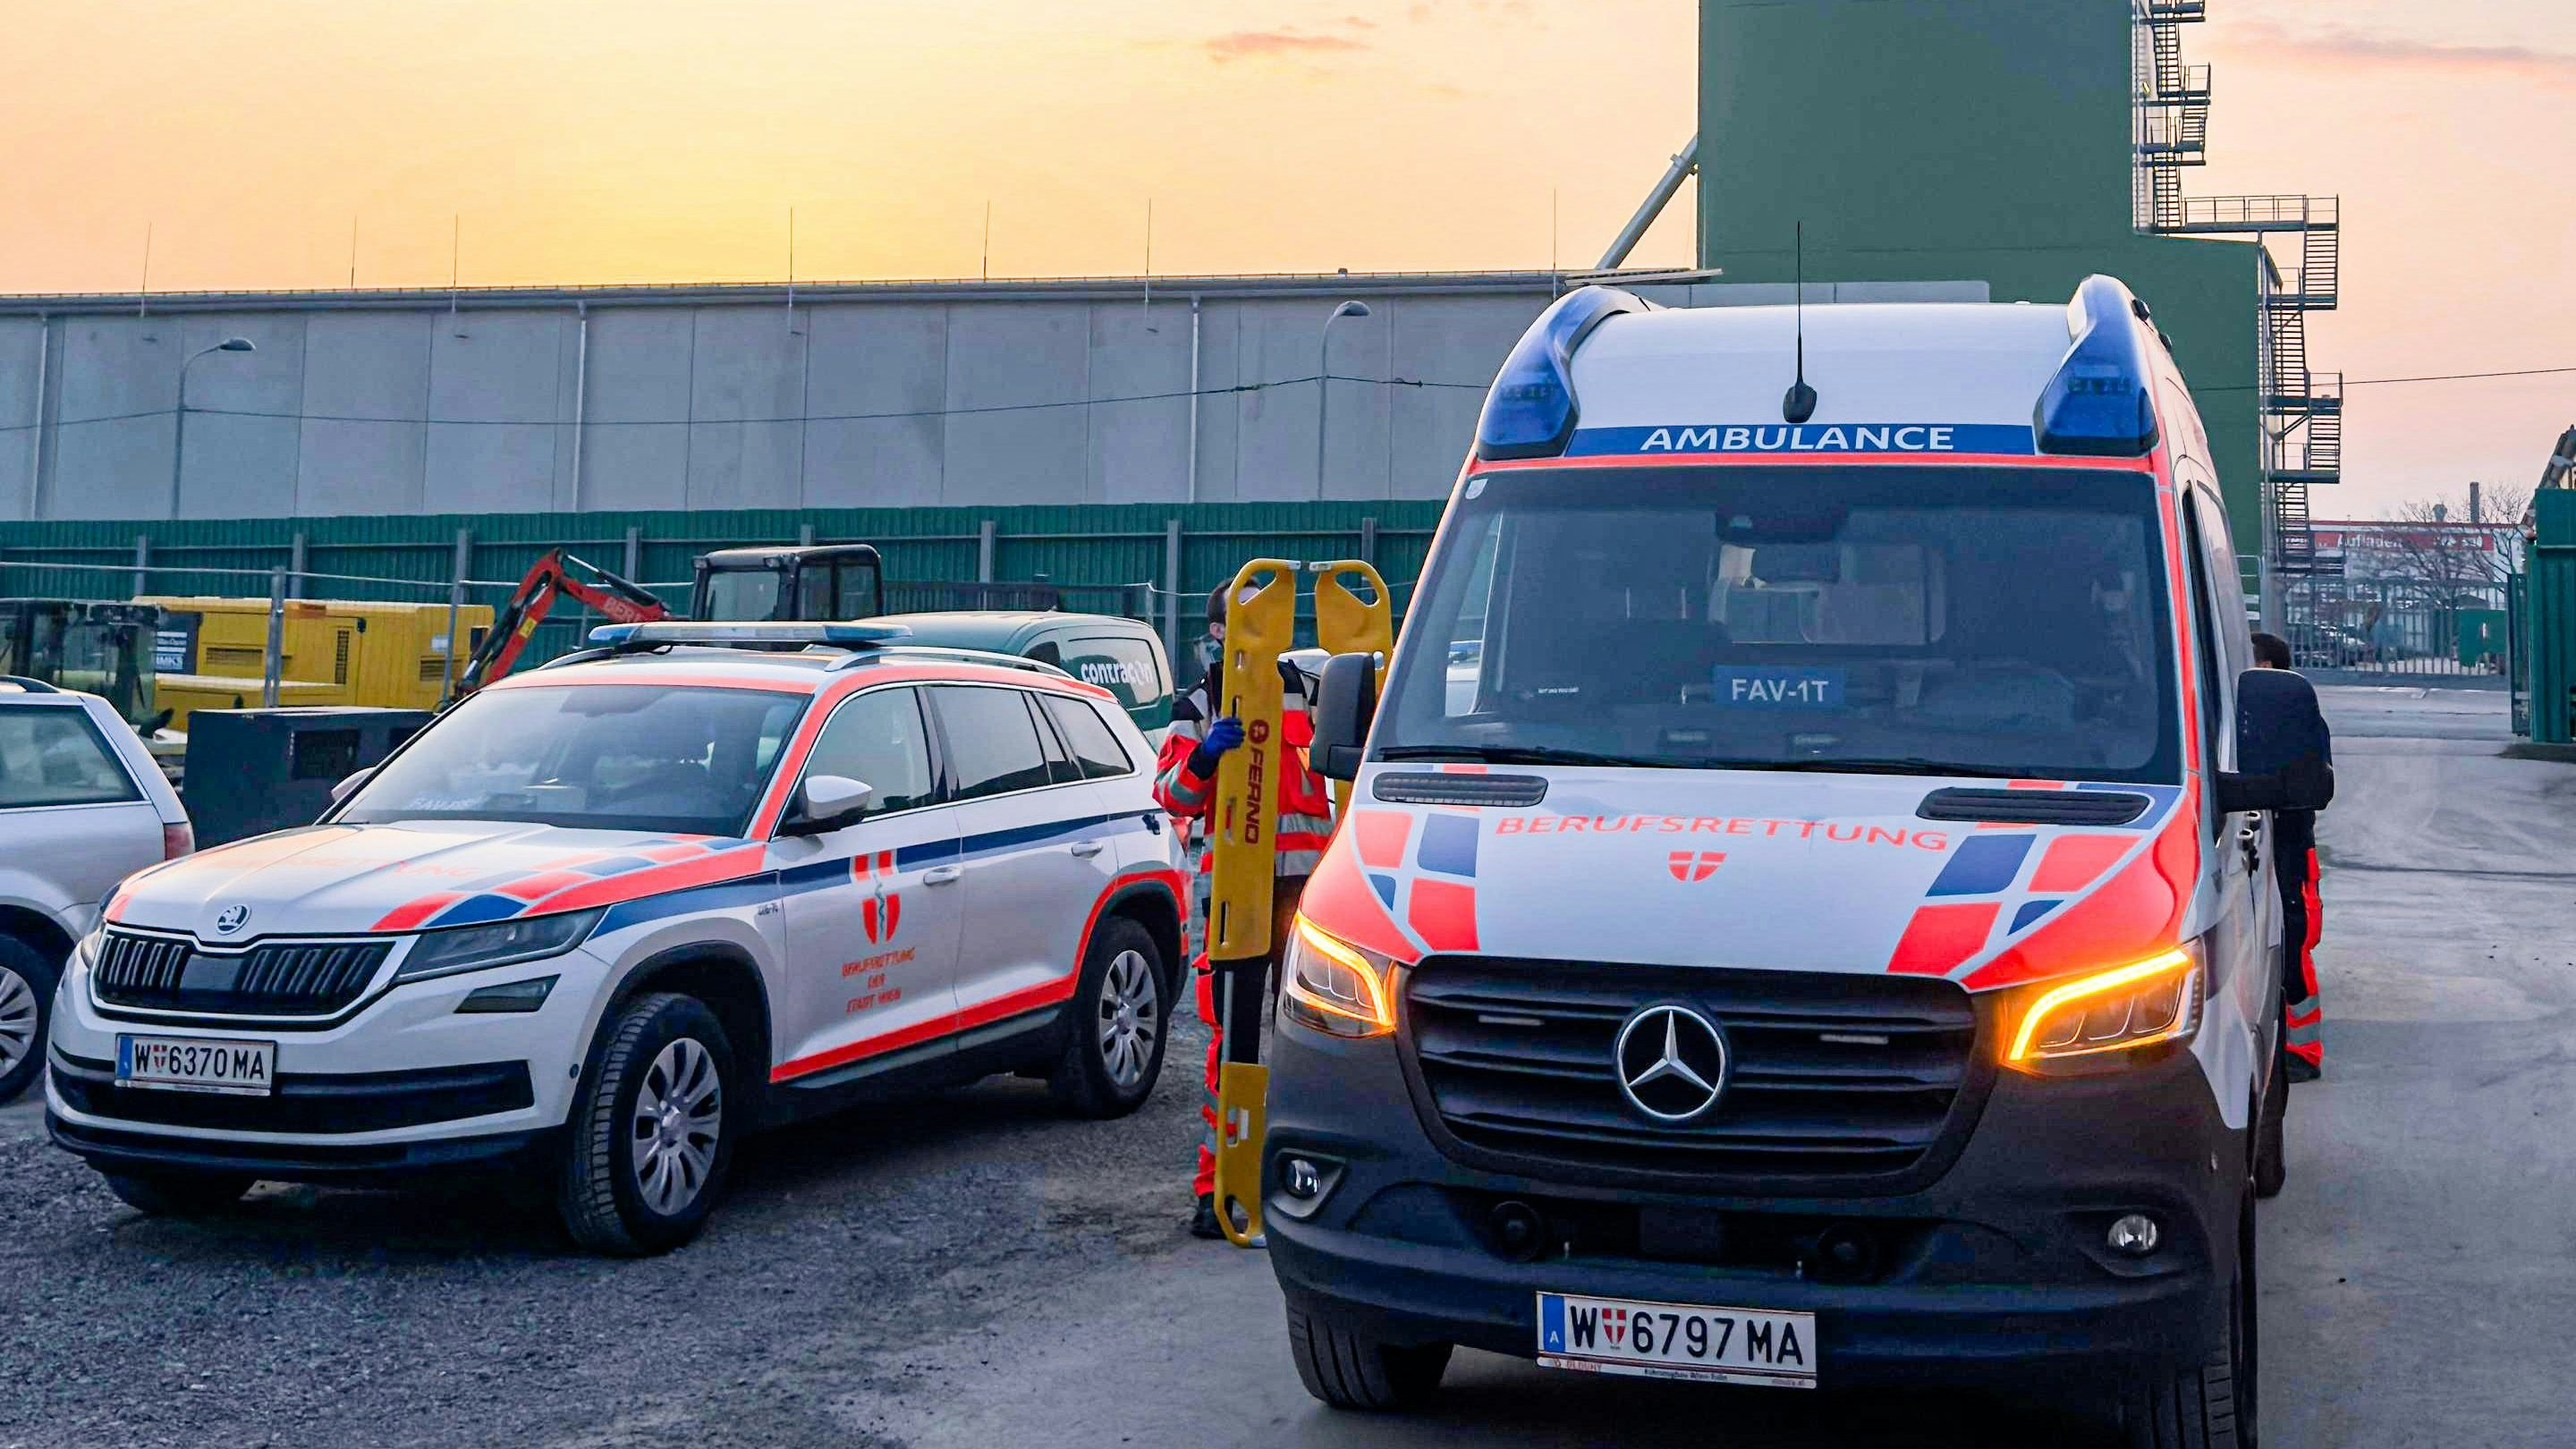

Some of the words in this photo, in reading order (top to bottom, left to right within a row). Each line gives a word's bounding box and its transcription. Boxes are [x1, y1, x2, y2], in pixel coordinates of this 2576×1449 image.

[1640, 427, 1953, 450] AMBULANCE
[1080, 660, 1154, 686] contracon
[1732, 678, 1830, 702] FAV-1T
[1244, 747, 1264, 844] FERNO
[1496, 815, 1948, 852] BERUFSRETTUNG
